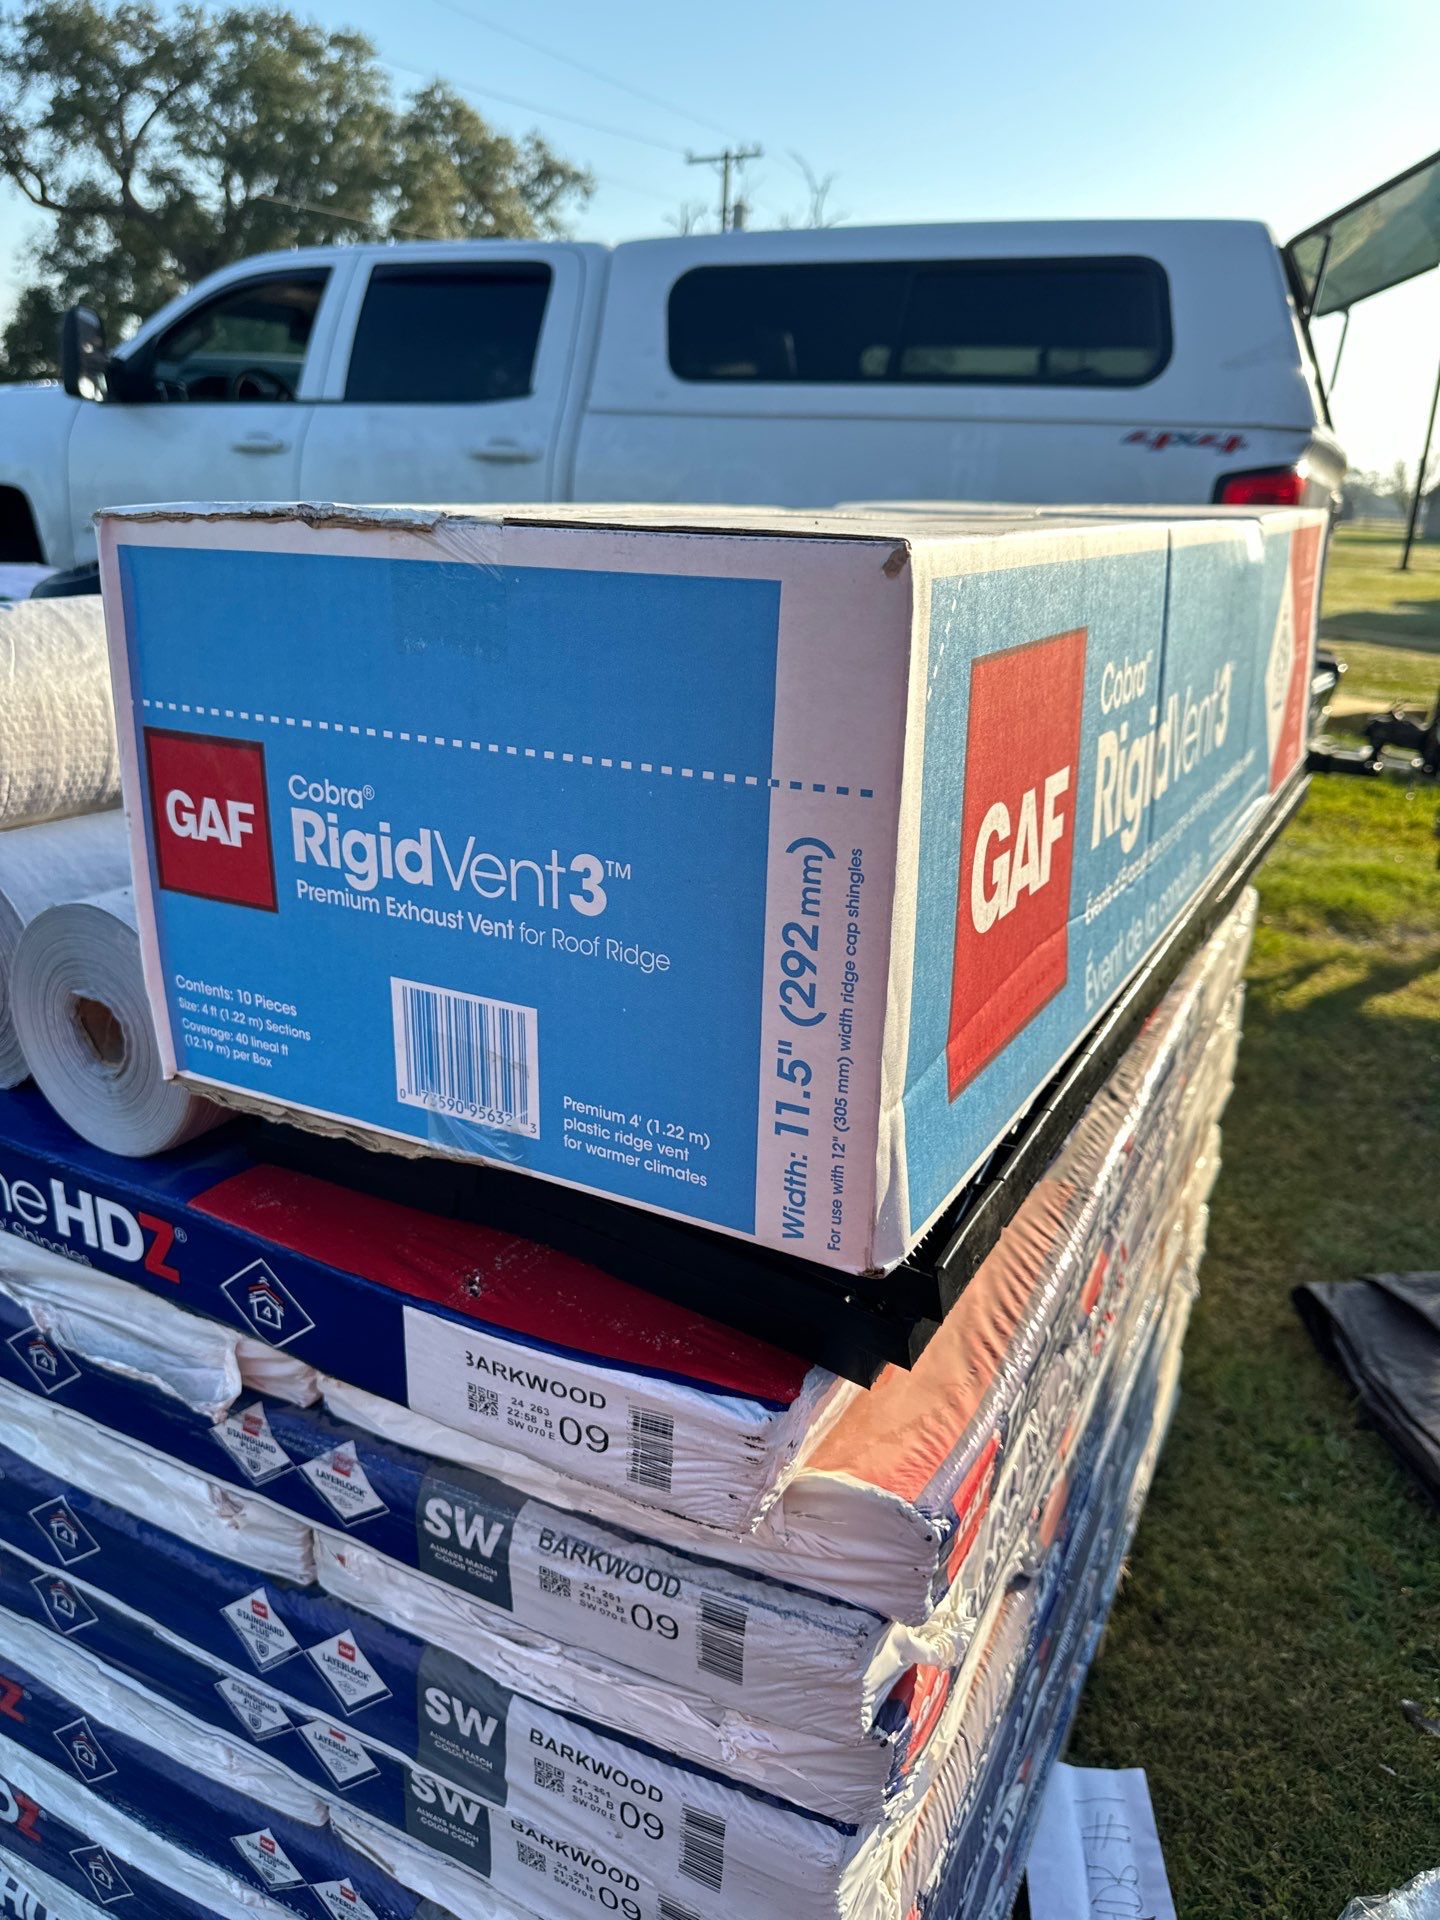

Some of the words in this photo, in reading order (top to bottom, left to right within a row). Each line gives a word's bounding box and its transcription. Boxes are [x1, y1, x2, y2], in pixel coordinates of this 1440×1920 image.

[166, 789, 256, 848] GAF
[971, 765, 1070, 934] GAF
[845, 848, 865, 918] shingles
[296, 879, 380, 914] Premium
[386, 896, 464, 930] Exhaust
[467, 911, 514, 940] Vent
[519, 921, 546, 946] for
[552, 928, 600, 957] Roof
[606, 938, 671, 974] Ridge
[845, 922, 861, 956] cap
[176, 974, 234, 1001] Contents:
[237, 989, 252, 1005] 10
[255, 993, 298, 1017] Pieces
[840, 961, 859, 1004] ridge
[178, 997, 200, 1013] Size:
[202, 1003, 210, 1014] 4
[210, 1005, 218, 1017] ft
[220, 1008, 246, 1025] (1.22
[249, 1017, 264, 1032] m)
[266, 1020, 312, 1041] Sections
[182, 1017, 234, 1042] Coverage:
[235, 1032, 249, 1046] 40
[251, 1035, 280, 1053] lineal
[281, 1044, 289, 1056] ft
[839, 1006, 853, 1052] width
[185, 1034, 214, 1050] (12.19
[216, 1043, 231, 1059] m)
[233, 1049, 251, 1061] per
[252, 1051, 273, 1068] Box
[774, 1039, 813, 1137] 11.5"
[837, 1056, 854, 1094] mm)
[400, 1088, 406, 1100] 0
[530, 1123, 537, 1134] 3
[563, 1095, 626, 1124] Premium
[629, 1114, 642, 1128] 4'
[646, 1119, 684, 1140] (1.22
[688, 1131, 711, 1151] m)
[834, 1098, 849, 1132] (305
[563, 1117, 611, 1140] plastic
[614, 1130, 653, 1151] ridge
[657, 1143, 690, 1162] vent
[832, 1136, 845, 1159] 12"
[563, 1134, 582, 1149] for
[585, 1141, 640, 1167] warmer
[643, 1159, 708, 1187] climates
[782, 1152, 808, 1239] Width:
[831, 1165, 844, 1195] with
[830, 1199, 842, 1221] use
[827, 1228, 840, 1251] For
[507, 1407, 537, 1424] 22:58
[545, 1419, 553, 1429] B
[511, 1397, 524, 1407] 24
[530, 1404, 550, 1416] 263
[507, 1417, 525, 1430] SW
[527, 1425, 546, 1437] 070
[559, 1416, 609, 1453] 09
[423, 1497, 505, 1559] SW
[430, 1543, 463, 1562] ALWAYS
[465, 1557, 498, 1577] MATCH
[539, 1527, 682, 1599] BARKWOOD
[579, 1599, 597, 1611] SW
[631, 1603, 679, 1640] 09
[425, 1687, 498, 1747] SW
[462, 1748, 493, 1769] MATCH
[530, 1727, 664, 1803] BARKWOOD
[411, 1769, 480, 1826] SW
[416, 1807, 447, 1826] ALWAYS
[572, 1785, 600, 1804] 21:33
[606, 1800, 614, 1810] B
[572, 1795, 588, 1807] SW
[590, 1804, 607, 1817] 070
[421, 1817, 449, 1835] COLOR
[451, 1831, 475, 1847] CODE
[620, 1801, 664, 1840] 09
[511, 1819, 640, 1892] BARKWOOD
[571, 1884, 587, 1897] 070
[599, 1887, 641, 1920] 09
